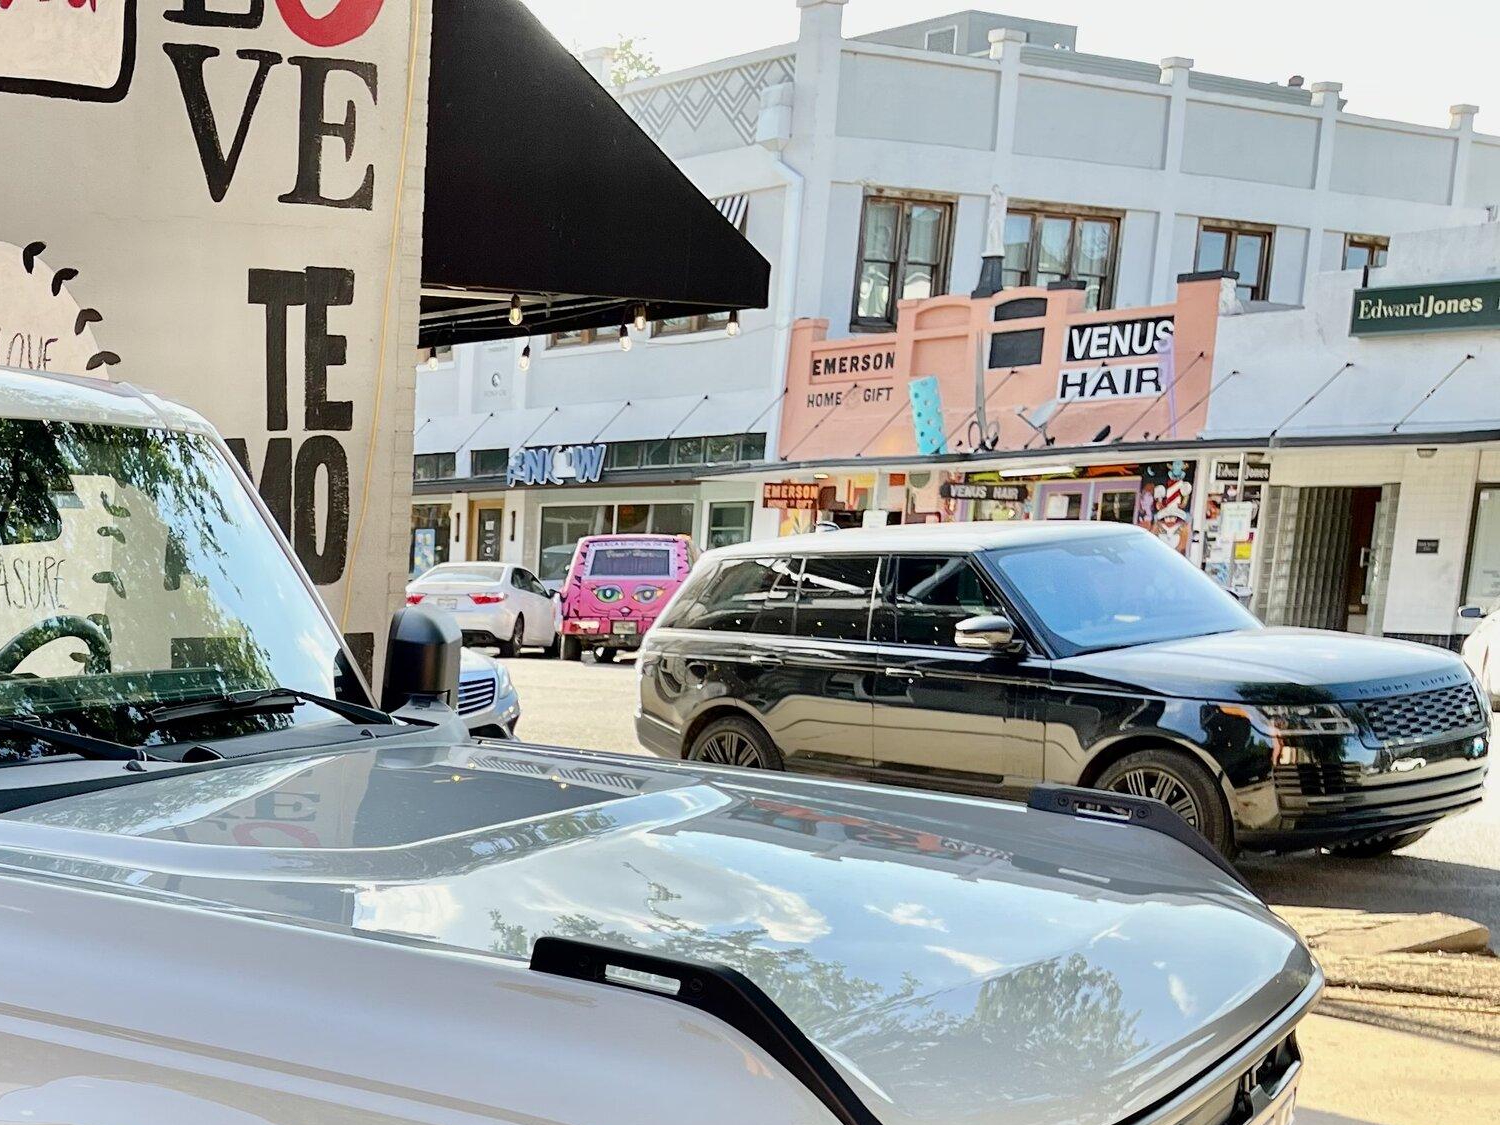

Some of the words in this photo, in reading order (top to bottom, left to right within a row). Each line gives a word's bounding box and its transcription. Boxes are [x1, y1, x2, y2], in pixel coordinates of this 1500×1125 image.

[163, 43, 379, 210] VE
[248, 267, 354, 432] TE
[1071, 319, 1175, 360] VENUS
[812, 351, 895, 376] EMERSON
[807, 391, 842, 408] HOME
[863, 386, 894, 402] GIFT
[1060, 366, 1161, 399] HAIR
[764, 484, 819, 499] EMERSON
[950, 485, 987, 498] VENUS
[993, 486, 1019, 500] HAIR
